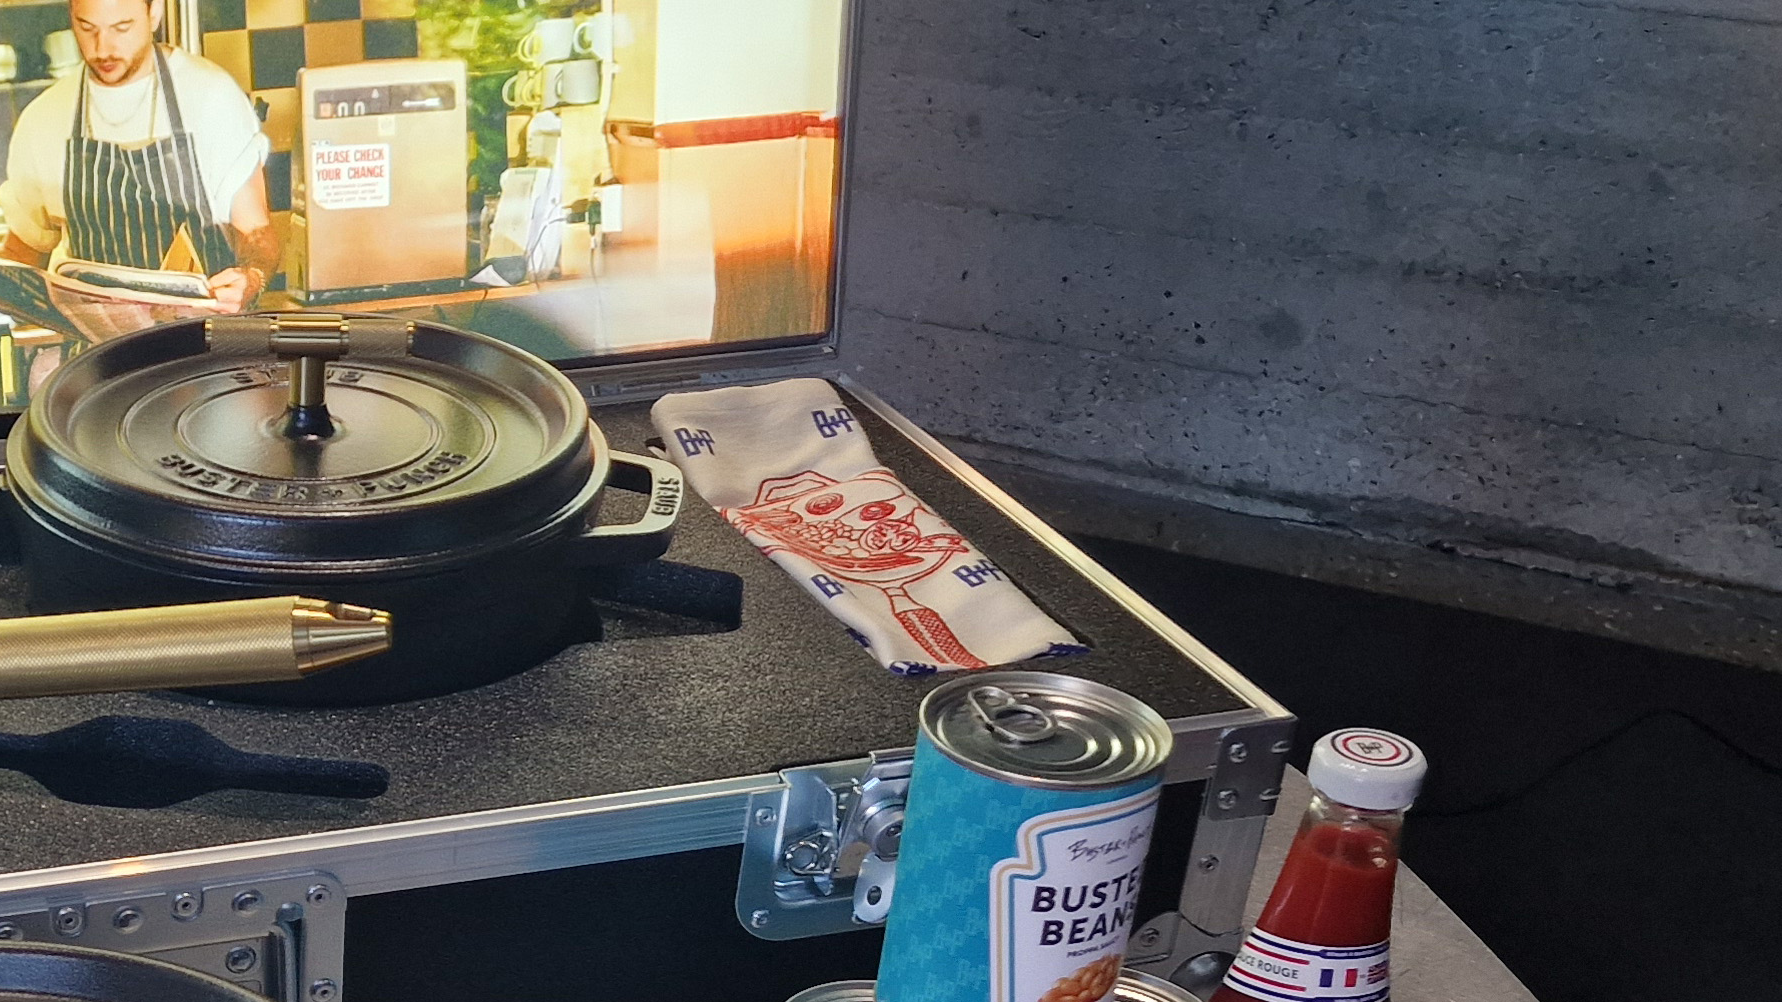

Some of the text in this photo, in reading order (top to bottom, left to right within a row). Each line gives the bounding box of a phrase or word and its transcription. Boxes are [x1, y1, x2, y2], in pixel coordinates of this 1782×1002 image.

[316, 148, 384, 164] PLEASE CHECK
[316, 165, 384, 181] YOUR CHANGE
[355, 450, 468, 499] PUNCH
[651, 477, 680, 516] STAUB
[1031, 865, 1140, 912] BUSTE
[1257, 960, 1300, 980] ROUGE
